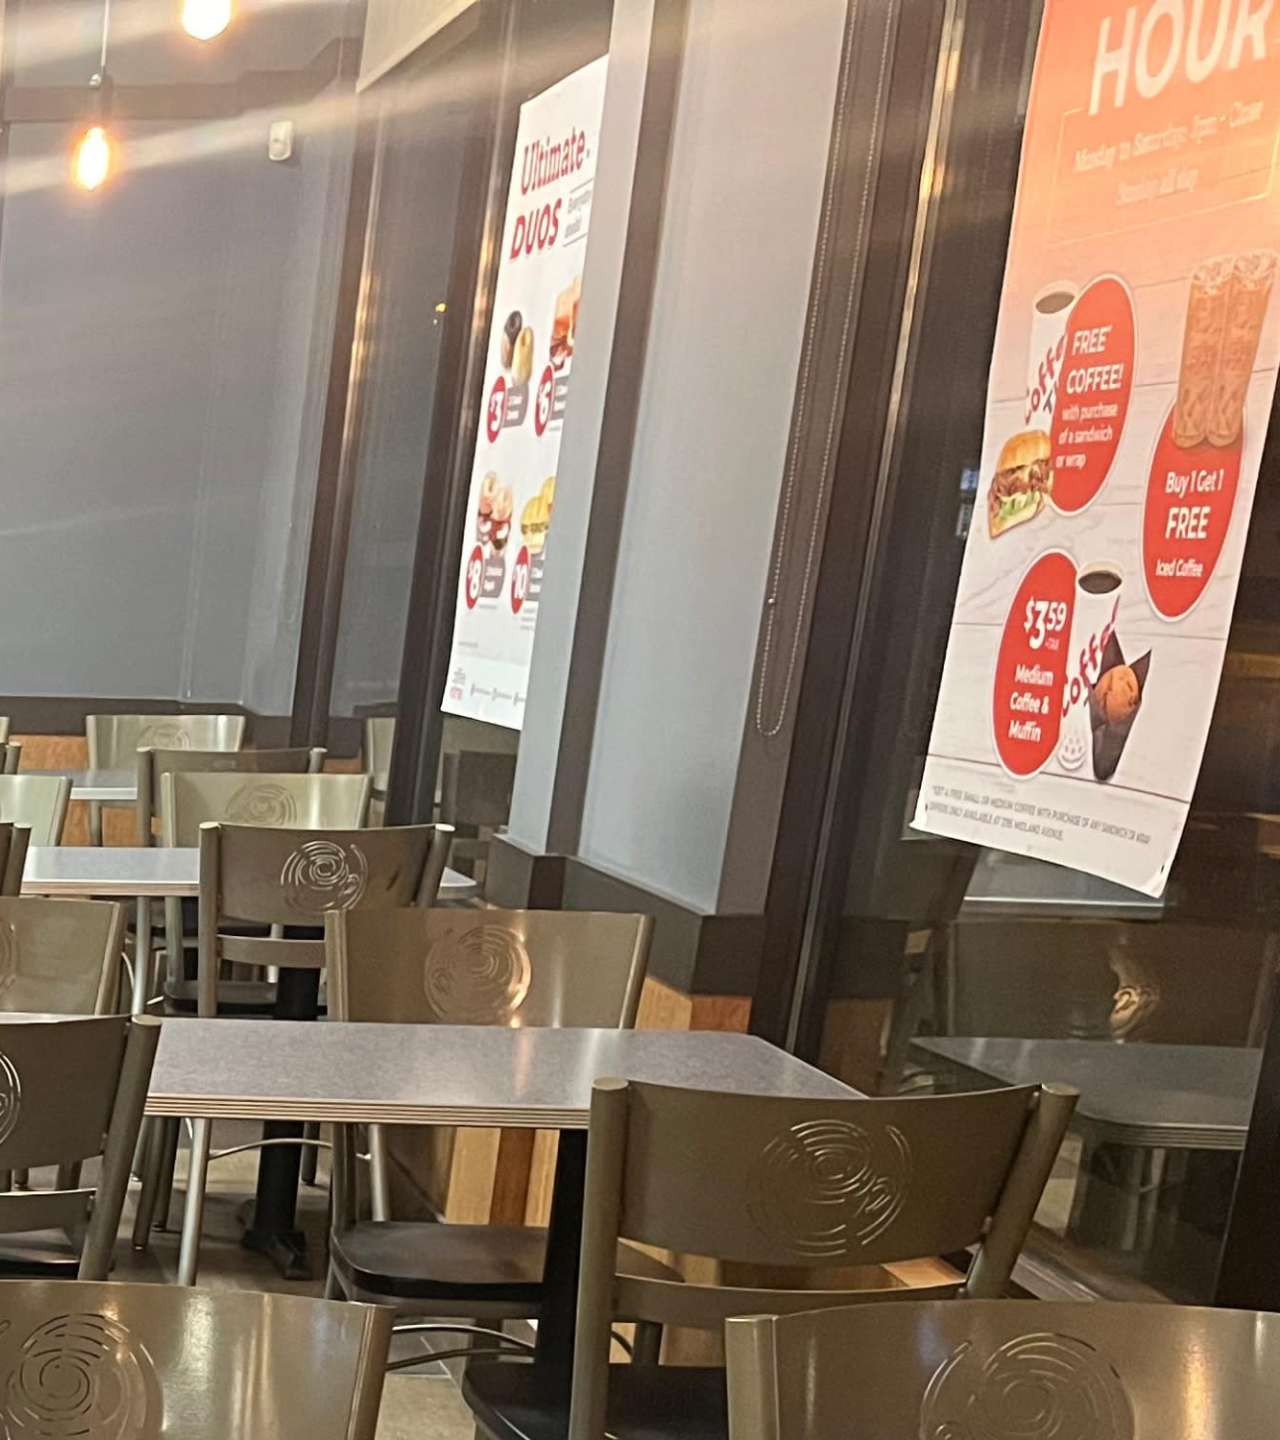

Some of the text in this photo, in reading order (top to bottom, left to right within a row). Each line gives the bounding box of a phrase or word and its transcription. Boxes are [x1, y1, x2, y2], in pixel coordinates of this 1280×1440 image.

[1088, 0, 1274, 116] HOUR
[521, 127, 585, 196] Ultimate
[509, 197, 562, 260] DUOS
[1066, 363, 1125, 395] COFFEE!
[1165, 468, 1225, 499] Buy 1 Get 1
[1165, 505, 1212, 540] FREE
[1155, 558, 1204, 577] Iced Coffee
[1014, 664, 1053, 687] Medium
[1010, 691, 1049, 715] Coffee &
[1008, 719, 1042, 742] Muffin
